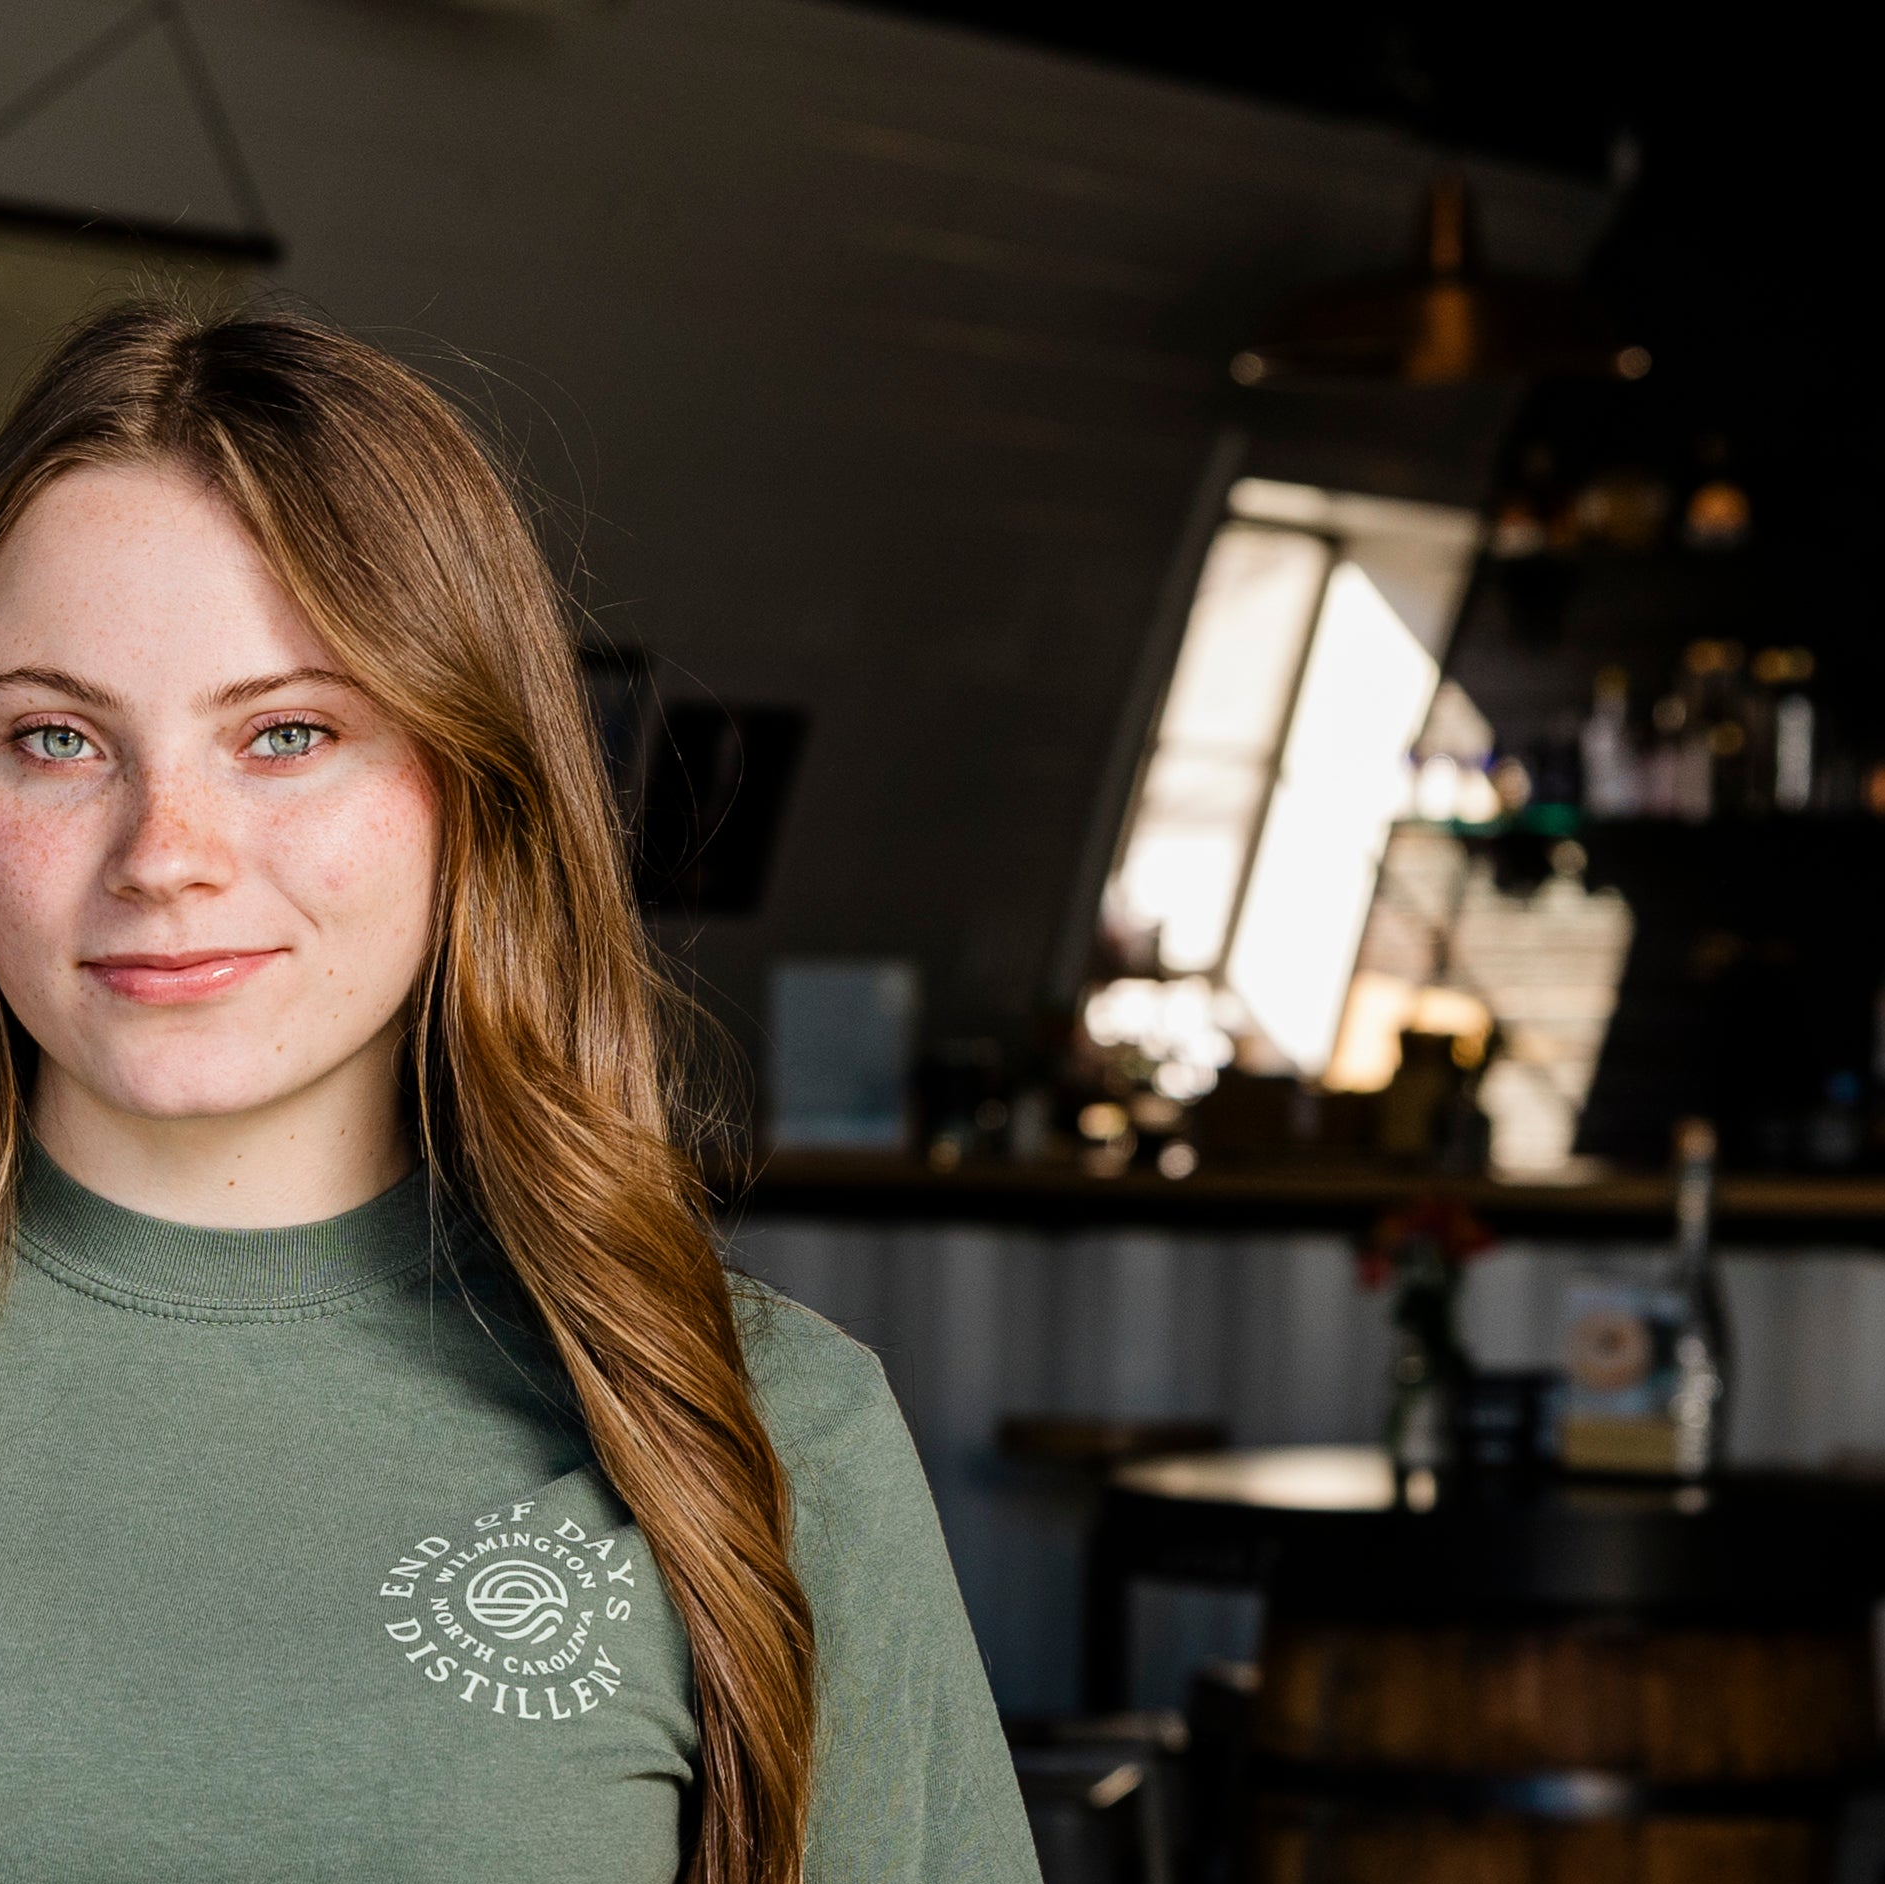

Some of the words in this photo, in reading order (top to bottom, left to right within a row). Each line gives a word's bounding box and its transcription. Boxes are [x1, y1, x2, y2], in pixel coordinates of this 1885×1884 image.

[379, 1536, 451, 1599] END
[474, 1501, 536, 1532] OF
[553, 1517, 635, 1622] DAYS
[434, 1532, 597, 1590] WILMINGTON
[384, 1617, 622, 1721] DISTILLERY
[430, 1597, 496, 1664] NORTH
[502, 1609, 594, 1676] CAROLINA
